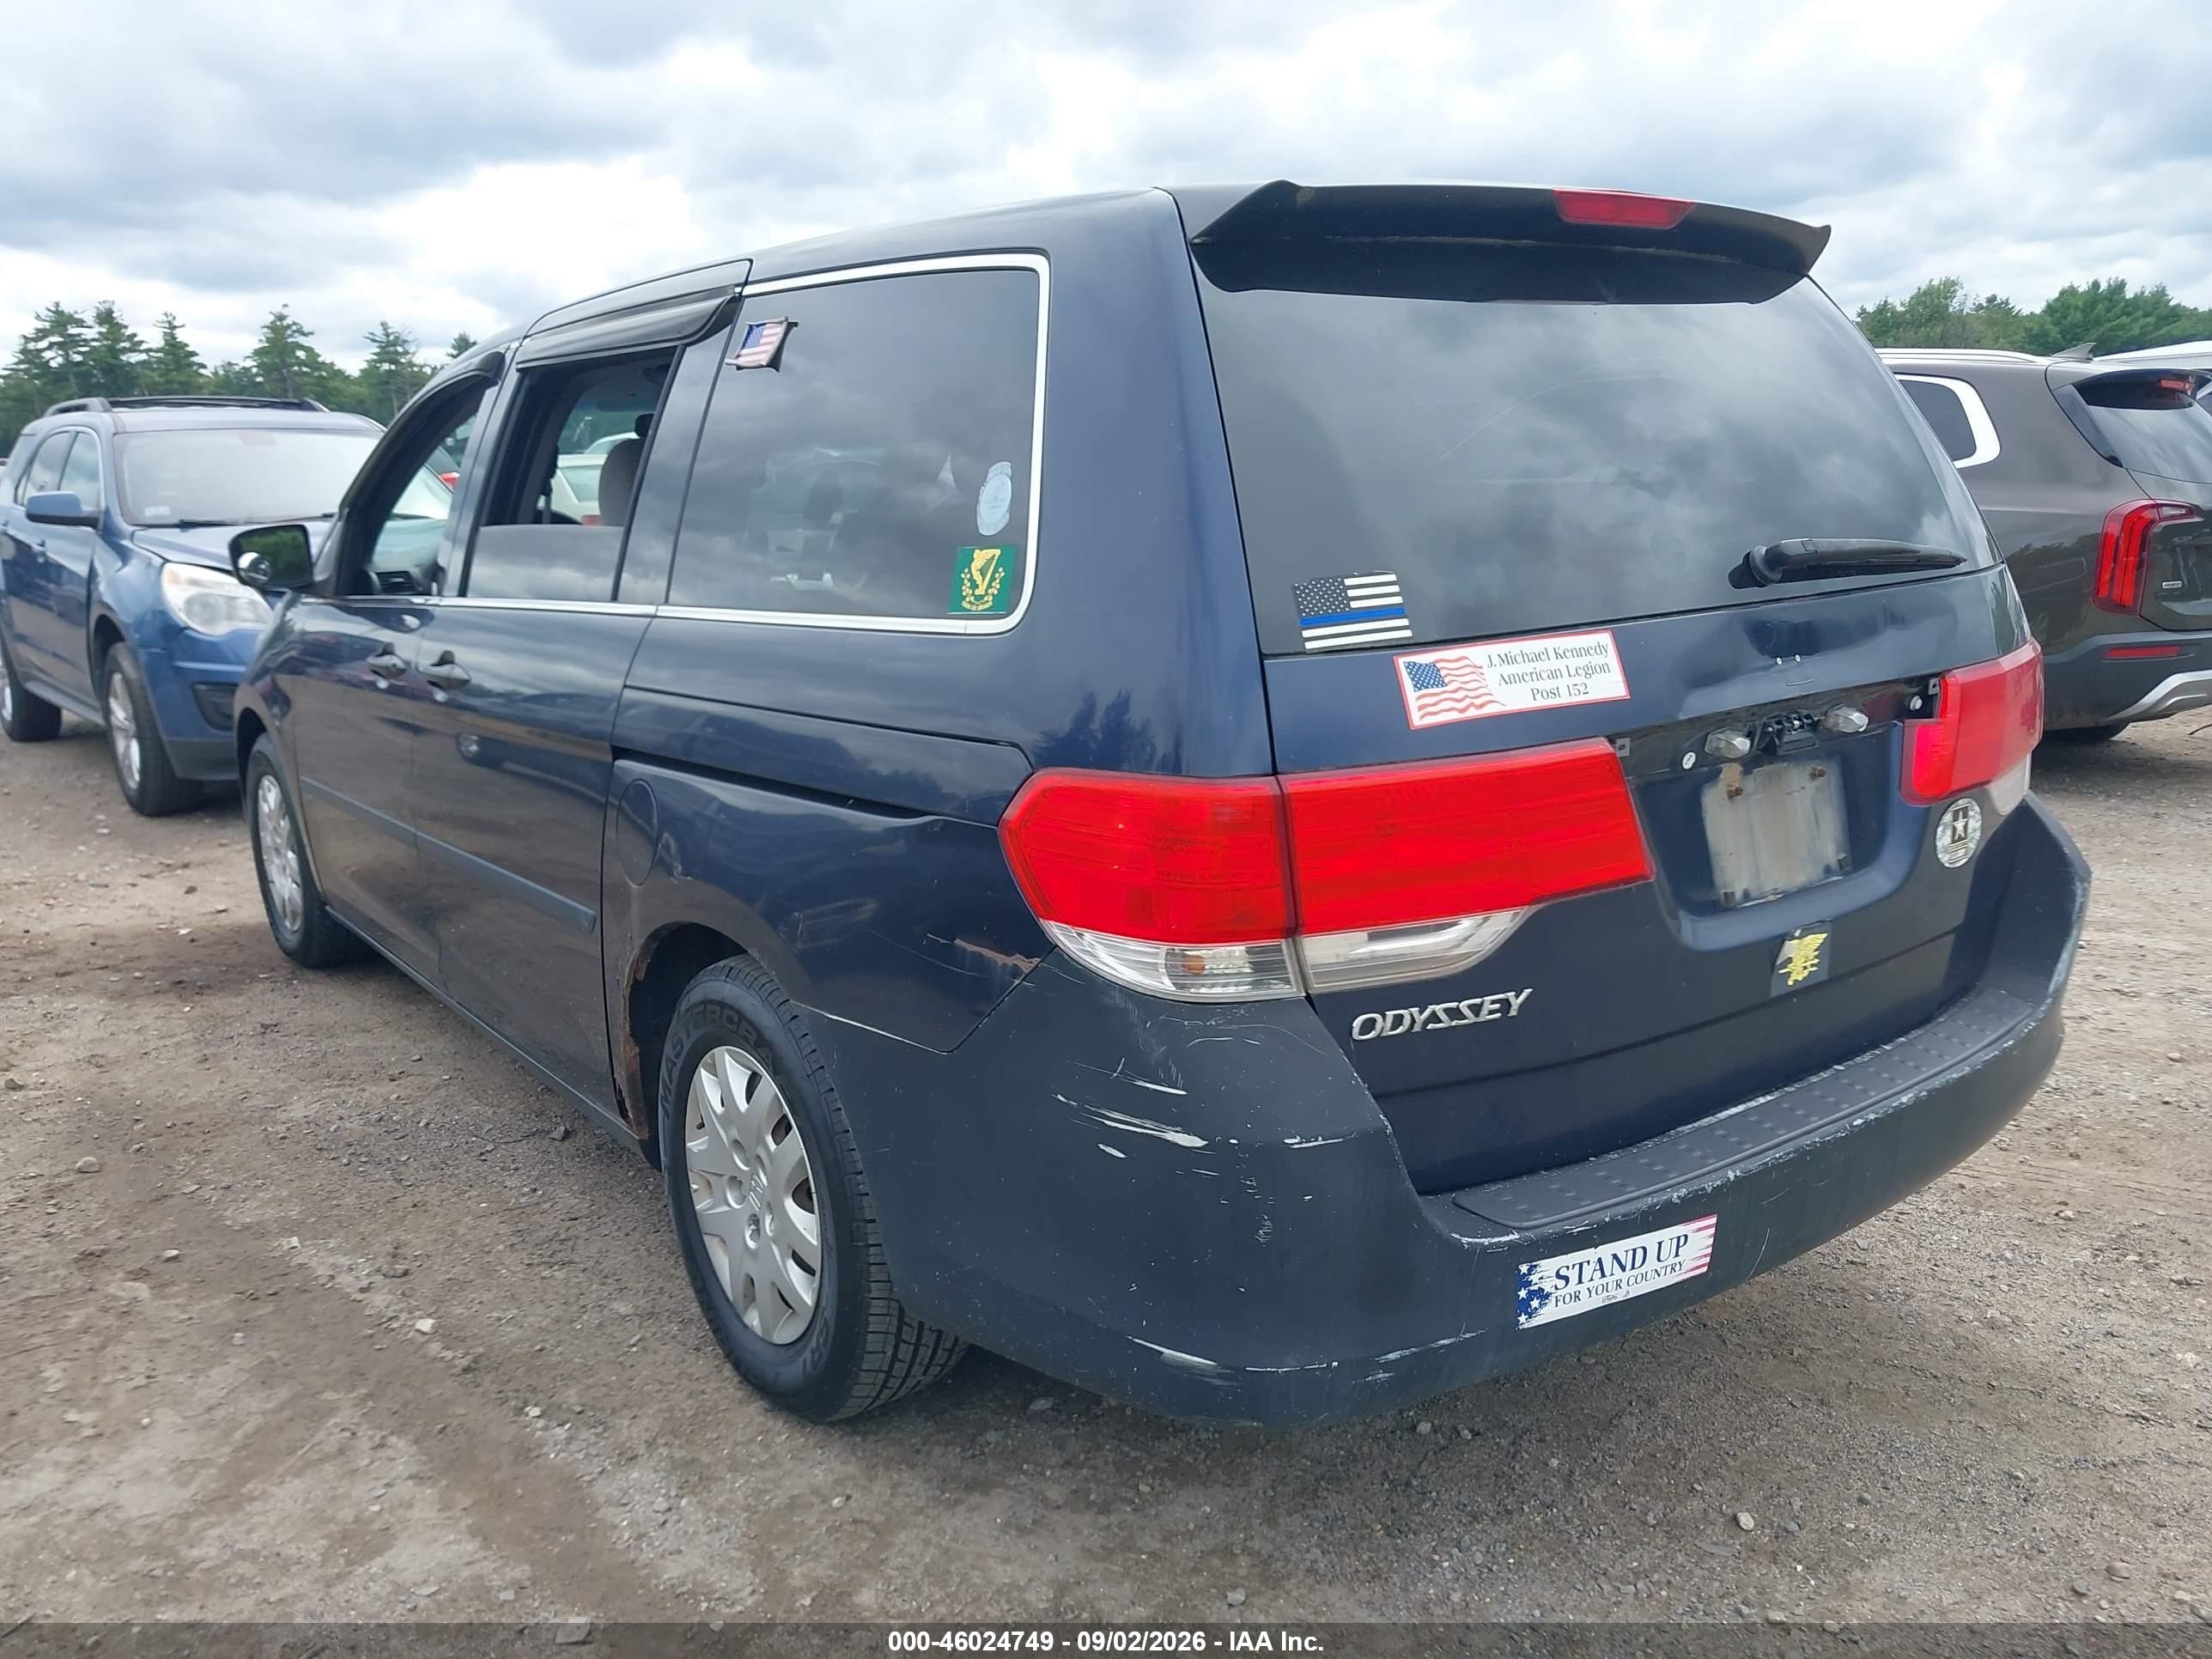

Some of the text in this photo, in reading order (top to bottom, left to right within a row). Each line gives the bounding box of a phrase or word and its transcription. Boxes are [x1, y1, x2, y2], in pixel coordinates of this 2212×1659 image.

[1486, 641, 1610, 669] J. Michael Kennedy
[1498, 661, 1611, 686] American Legion
[1530, 682, 1589, 702] Post 152
[1351, 988, 1534, 1041] ODYSSEY
[1553, 1233, 1689, 1291] STAND UP
[1553, 1290, 1582, 1308] FOR
[1587, 1279, 1623, 1299] YOUR
[1626, 1259, 1686, 1286] COUNTRY
